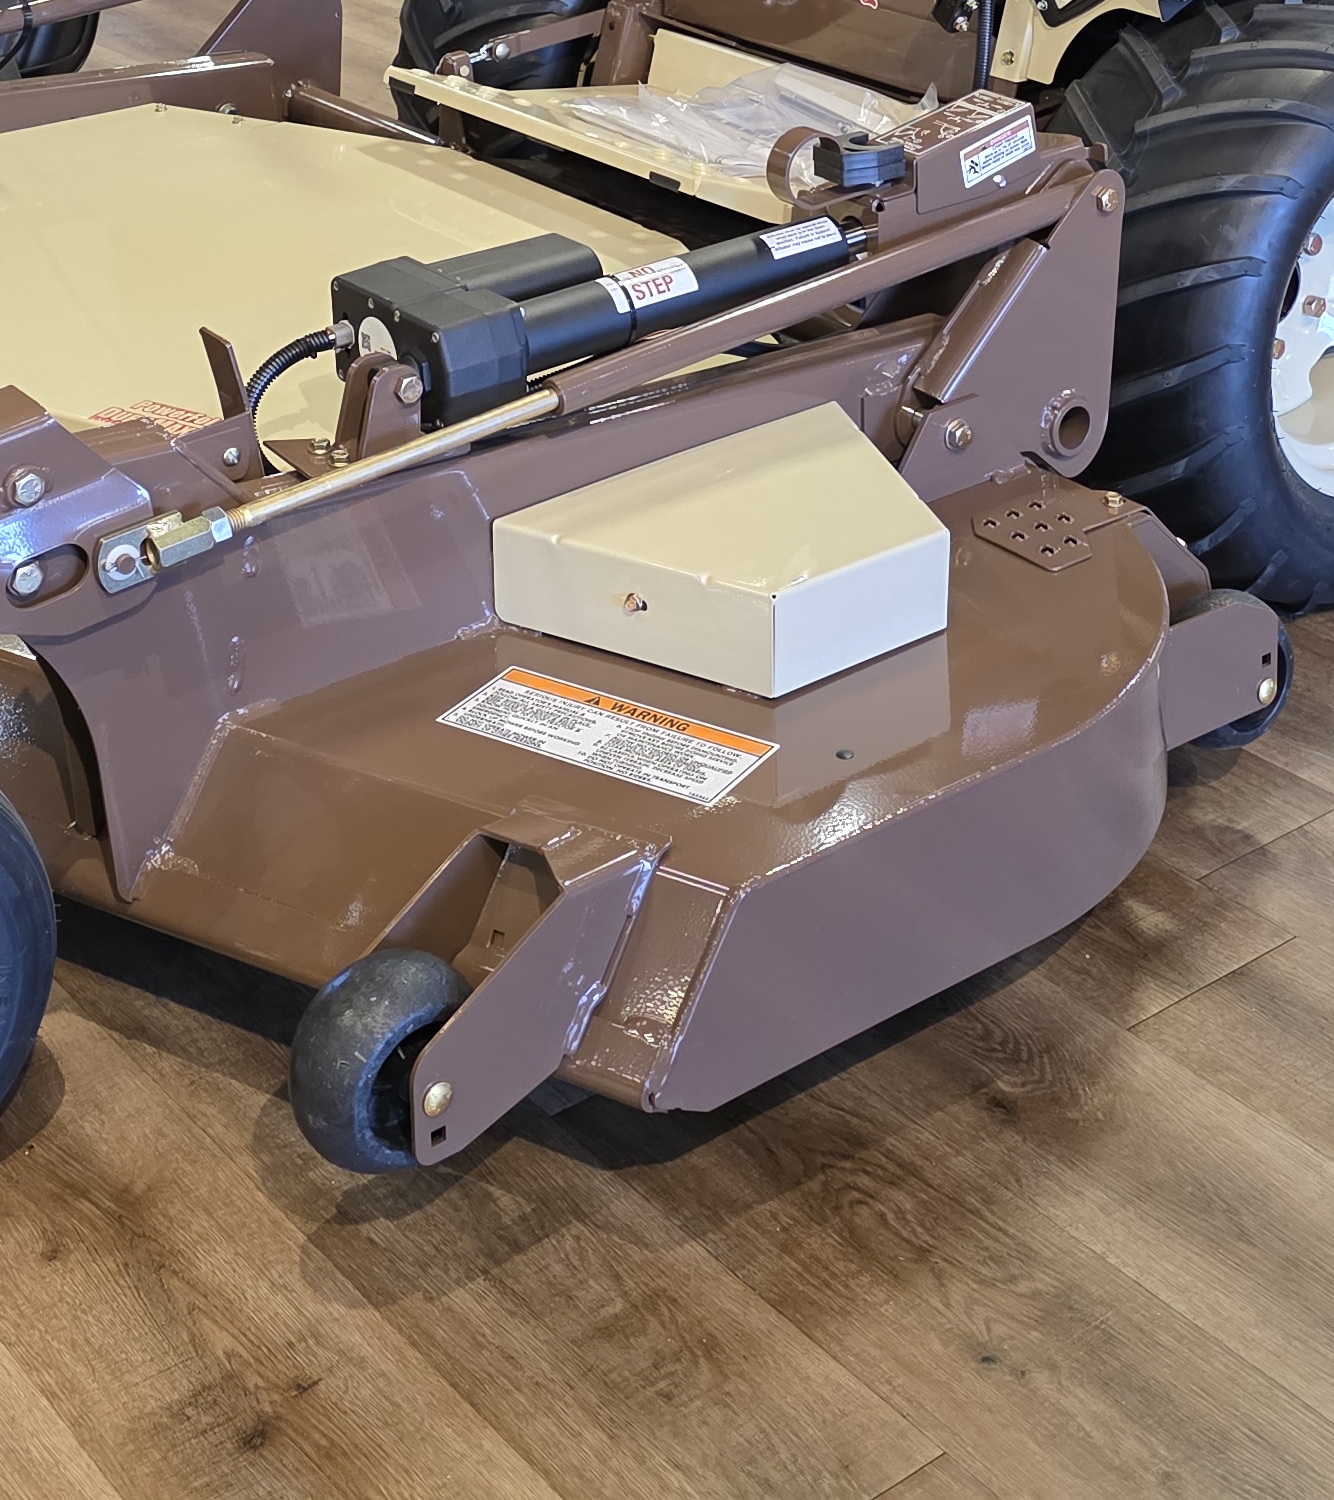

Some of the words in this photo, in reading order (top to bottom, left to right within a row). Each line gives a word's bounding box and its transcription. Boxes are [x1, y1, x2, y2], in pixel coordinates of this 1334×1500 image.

[629, 266, 656, 278] NO
[632, 274, 674, 301] STEP
[522, 689, 558, 702] SERIOUS
[556, 699, 587, 711] INJURY
[585, 708, 605, 716] CAN
[603, 713, 636, 726] RESULT
[634, 722, 661, 733] FROM
[659, 730, 696, 744] FAILURE
[706, 744, 745, 759] FOLLOW.
[610, 702, 690, 733] WARNING
